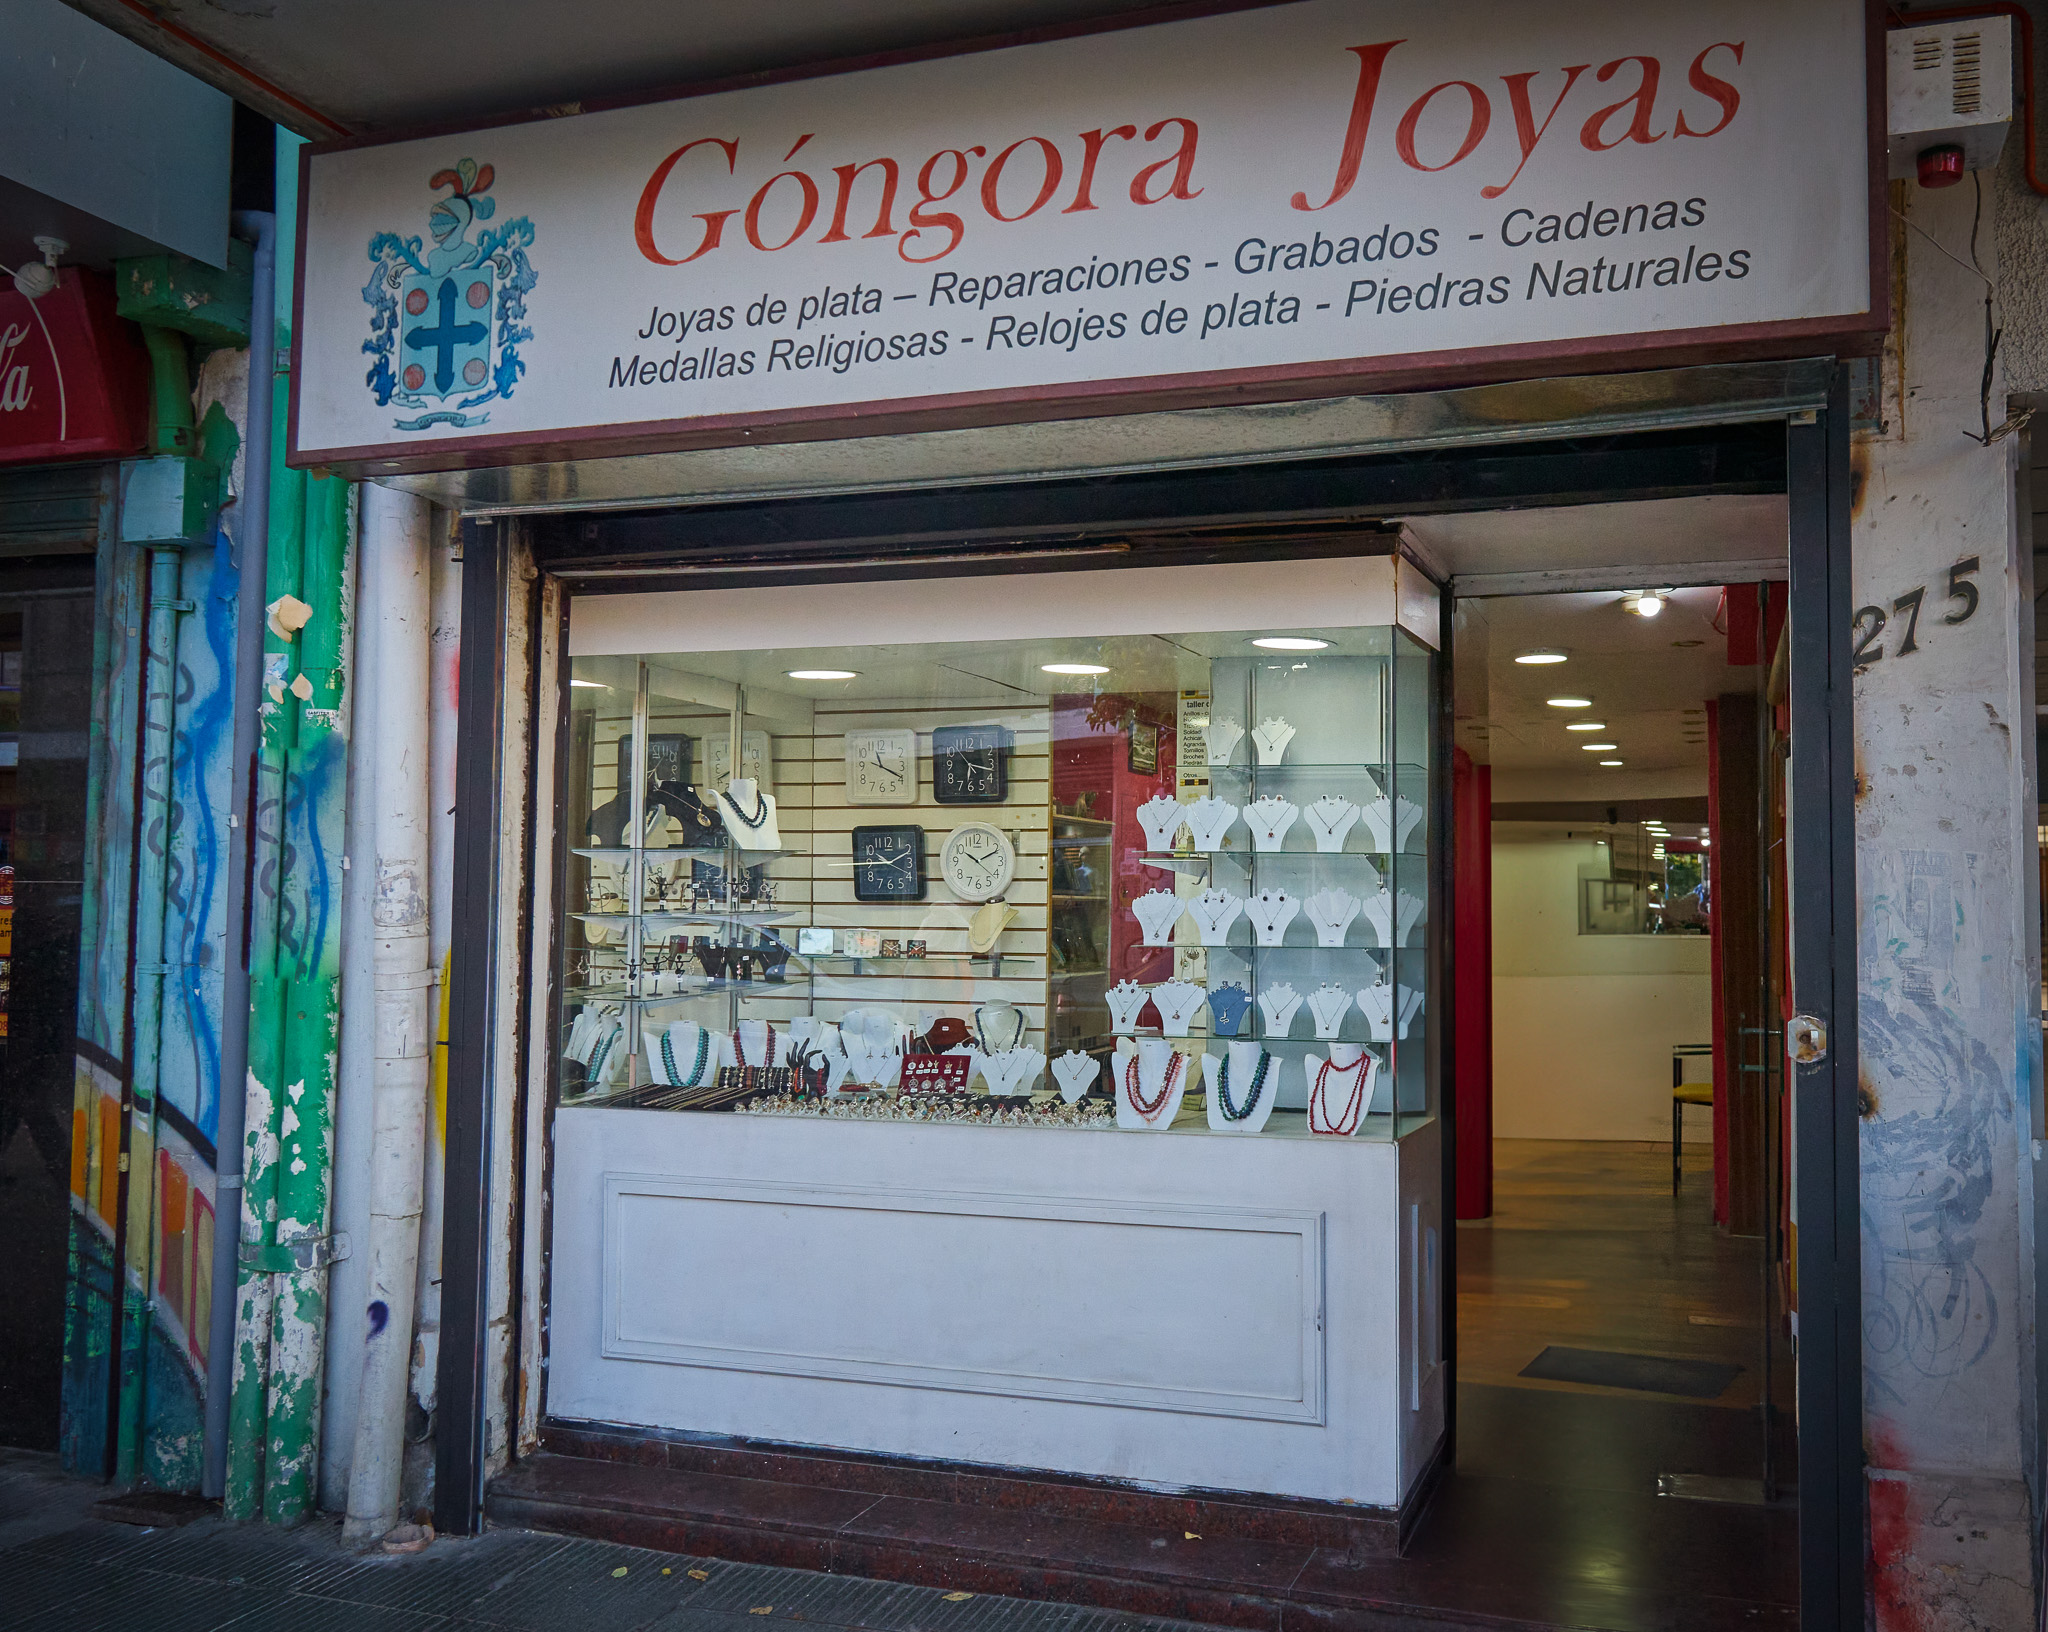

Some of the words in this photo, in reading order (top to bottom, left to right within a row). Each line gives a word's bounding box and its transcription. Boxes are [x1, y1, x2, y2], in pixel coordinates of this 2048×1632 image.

[634, 117, 1205, 266] Góngora
[1292, 39, 1745, 211] Joyas
[608, 346, 756, 389] Medallas
[766, 330, 949, 375] Religiosas
[986, 312, 1128, 353] Relojes
[1140, 300, 1189, 336] de
[1199, 289, 1301, 340] plata
[1344, 272, 1511, 318] Piedras
[1526, 244, 1752, 301] Naturales
[638, 306, 736, 344] Joyas
[745, 293, 787, 327] de
[796, 283, 883, 331] plata
[928, 254, 1192, 310] Reparaciones
[1234, 224, 1440, 275] Grabados
[1501, 197, 1707, 248] Cadenas
[1853, 556, 1981, 668] 275
